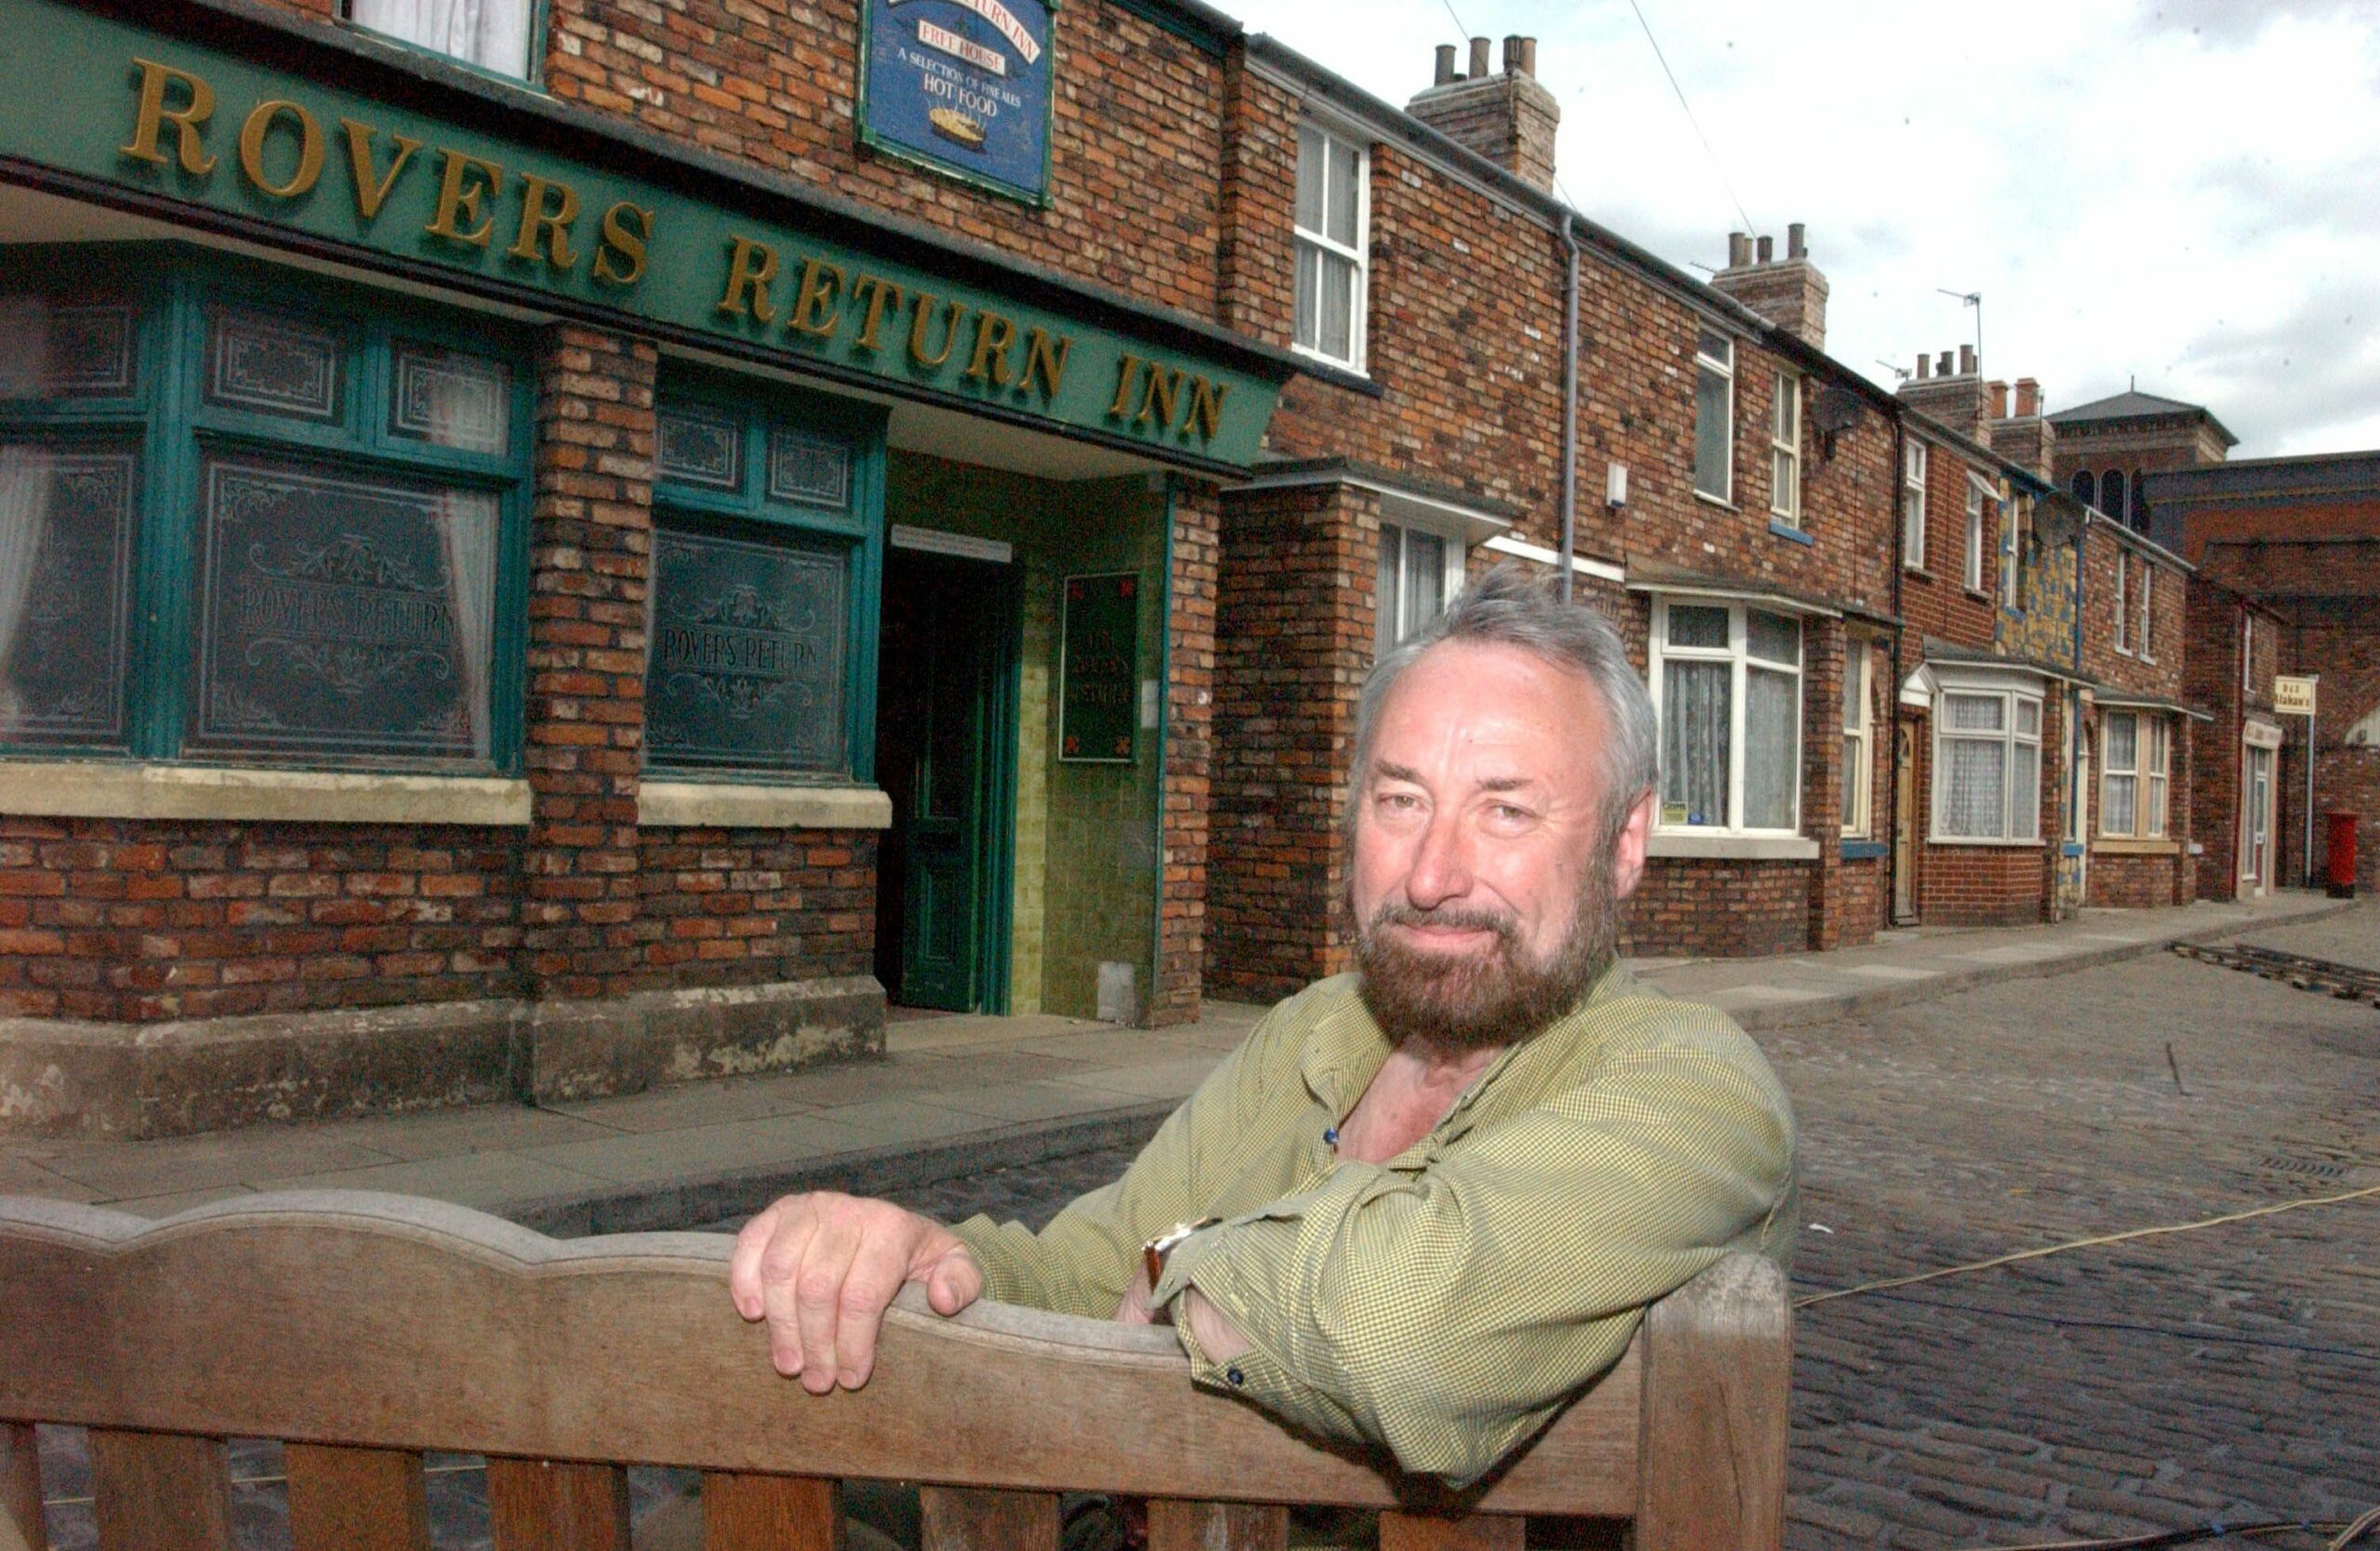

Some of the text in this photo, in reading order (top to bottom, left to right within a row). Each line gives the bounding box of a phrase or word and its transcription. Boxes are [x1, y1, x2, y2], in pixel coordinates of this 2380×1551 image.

[922, 24, 1000, 70] FREE HOUSE
[1012, 25, 1038, 59] INN
[897, 47, 1021, 108] A SELECTION OF FINE ALES
[924, 73, 998, 117] HOT FOOD
[119, 56, 1231, 440] ROVERS RETURN INN
[242, 583, 345, 628] ROVERS
[664, 629, 817, 671] ROVERS RETURN
